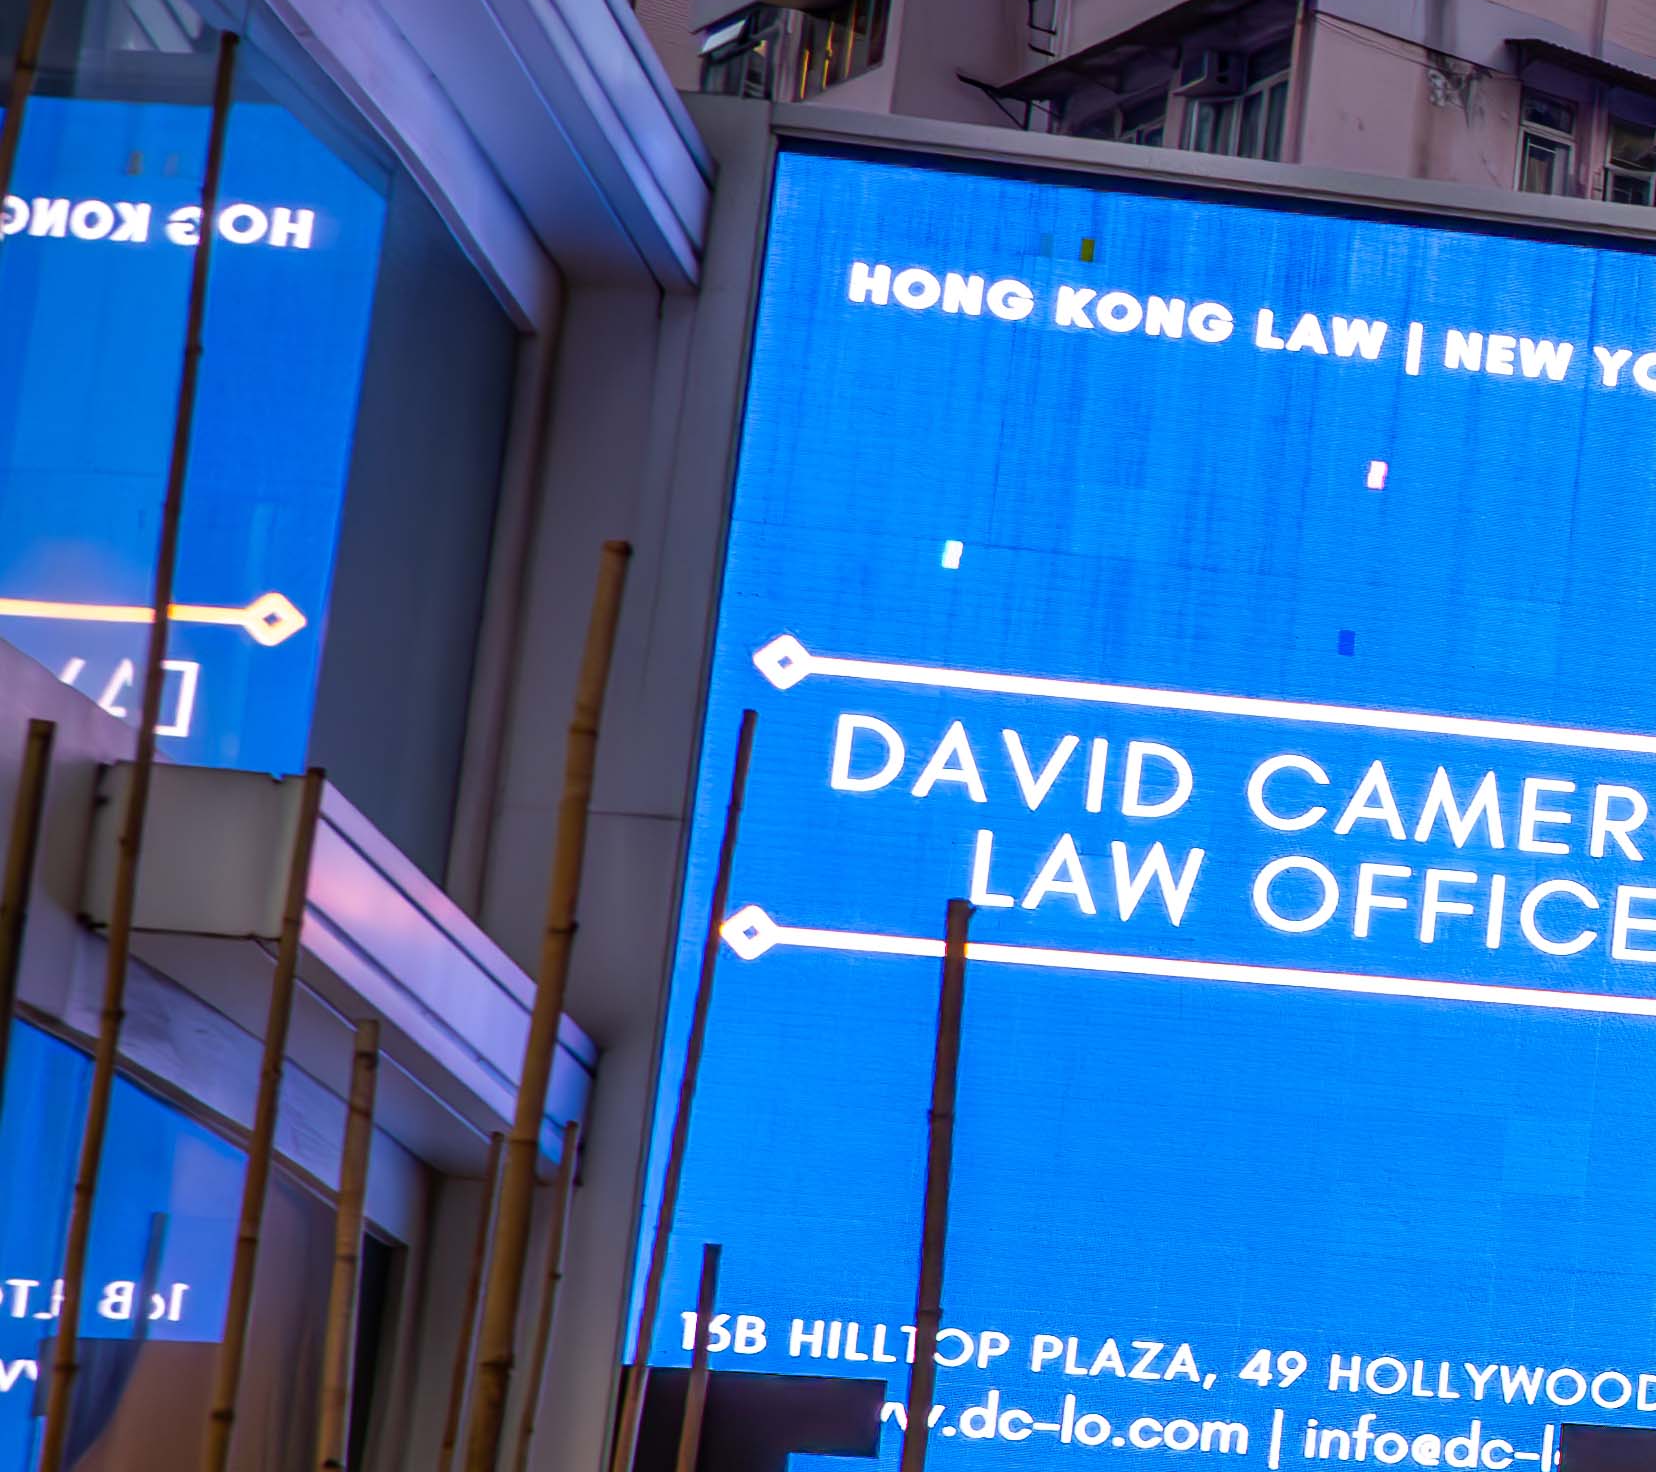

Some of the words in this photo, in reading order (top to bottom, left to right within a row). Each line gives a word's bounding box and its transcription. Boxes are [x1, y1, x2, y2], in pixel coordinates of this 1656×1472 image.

[848, 261, 1035, 321] HONG
[1054, 285, 1234, 343] KONG
[1255, 308, 1388, 360] LAW
[1444, 329, 1575, 381] NEW
[830, 712, 1195, 820] DAVID
[969, 829, 1205, 927] LAW
[681, 1311, 767, 1355] 16B
[789, 1318, 1010, 1369] HILLTOP
[1031, 1334, 1217, 1390] PLAZA,
[1238, 1348, 1308, 1389] 49
[1304, 1413, 1561, 1472] info@dc-l
